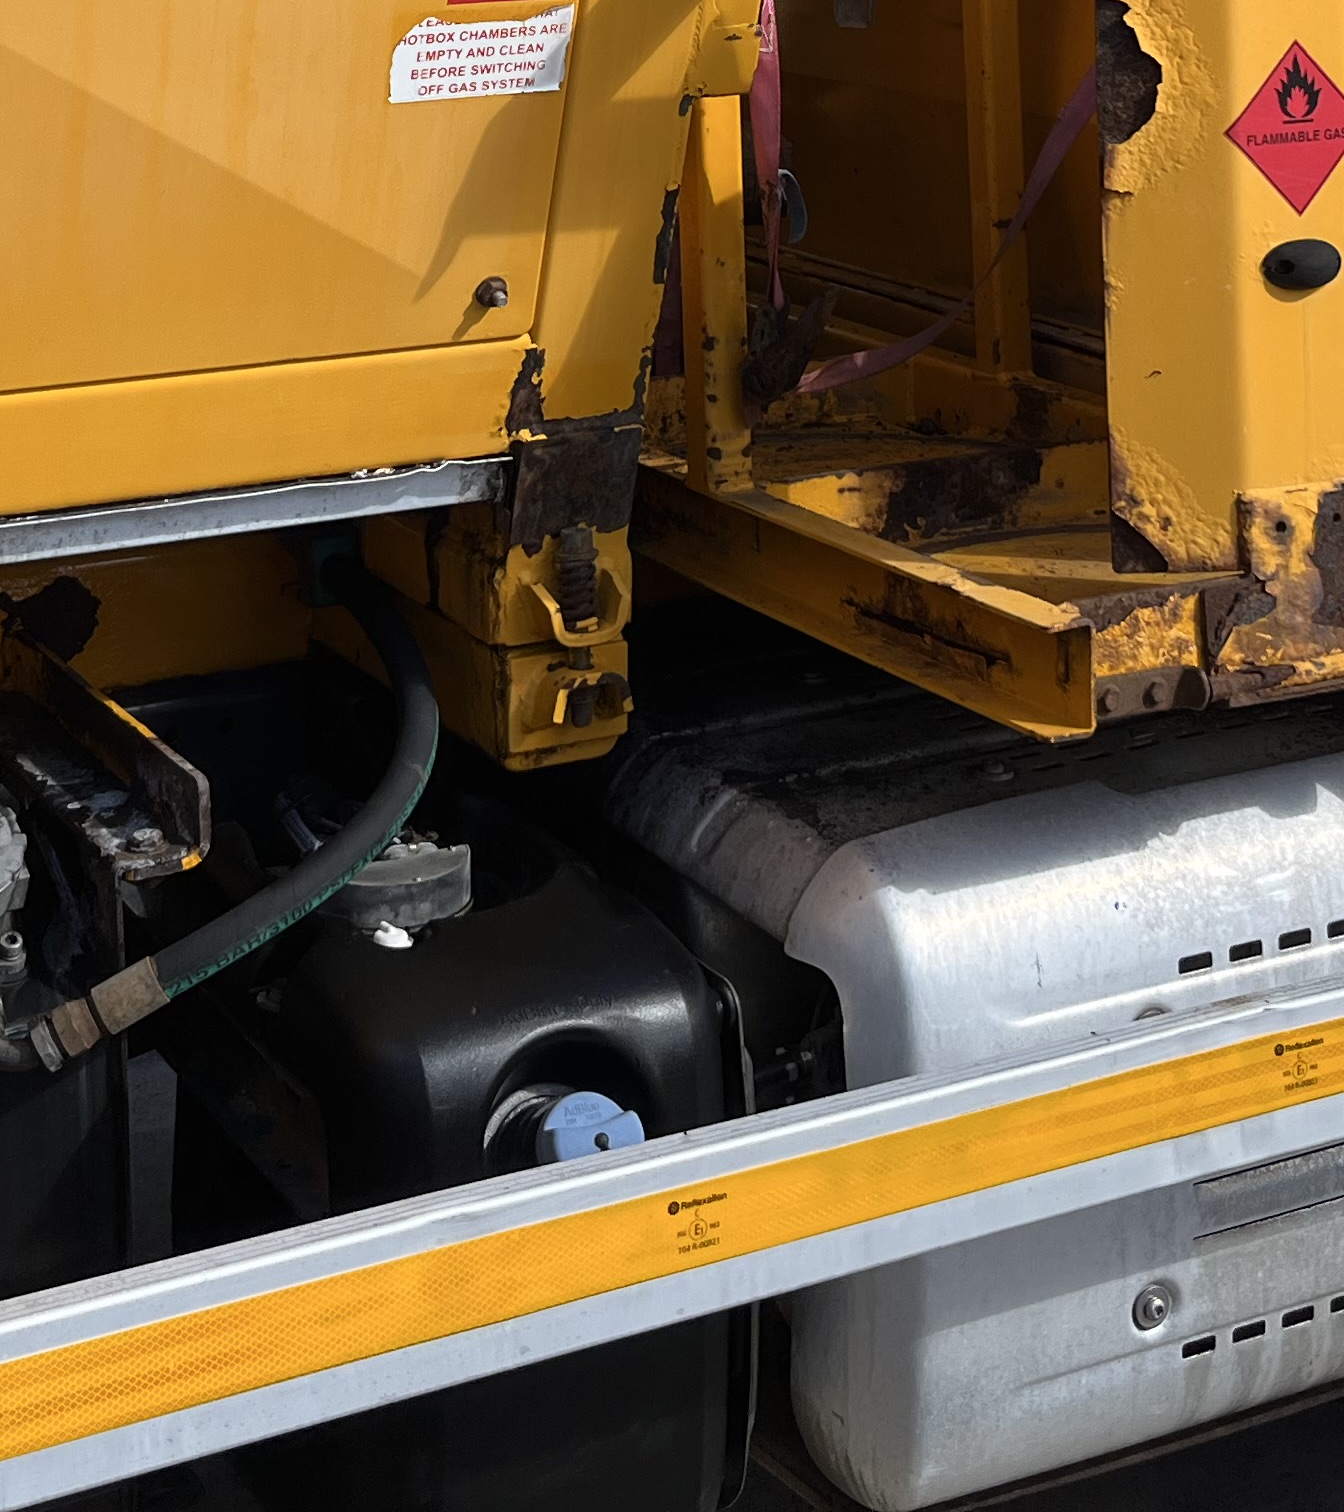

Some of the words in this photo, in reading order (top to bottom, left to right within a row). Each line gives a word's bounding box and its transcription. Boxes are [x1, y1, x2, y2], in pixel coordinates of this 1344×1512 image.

[459, 25, 536, 42] CHAMBERS
[540, 23, 568, 35] ARE
[417, 48, 463, 63] EMPTY
[466, 46, 495, 59] AND
[499, 43, 545, 56] CLEAN
[411, 65, 466, 80] BEFORE
[470, 60, 546, 76] SWITCHING
[417, 85, 444, 97] OFF
[449, 82, 477, 94] GAS
[481, 77, 535, 92] SYSTEM
[1247, 129, 1321, 147] FLAMMABLE
